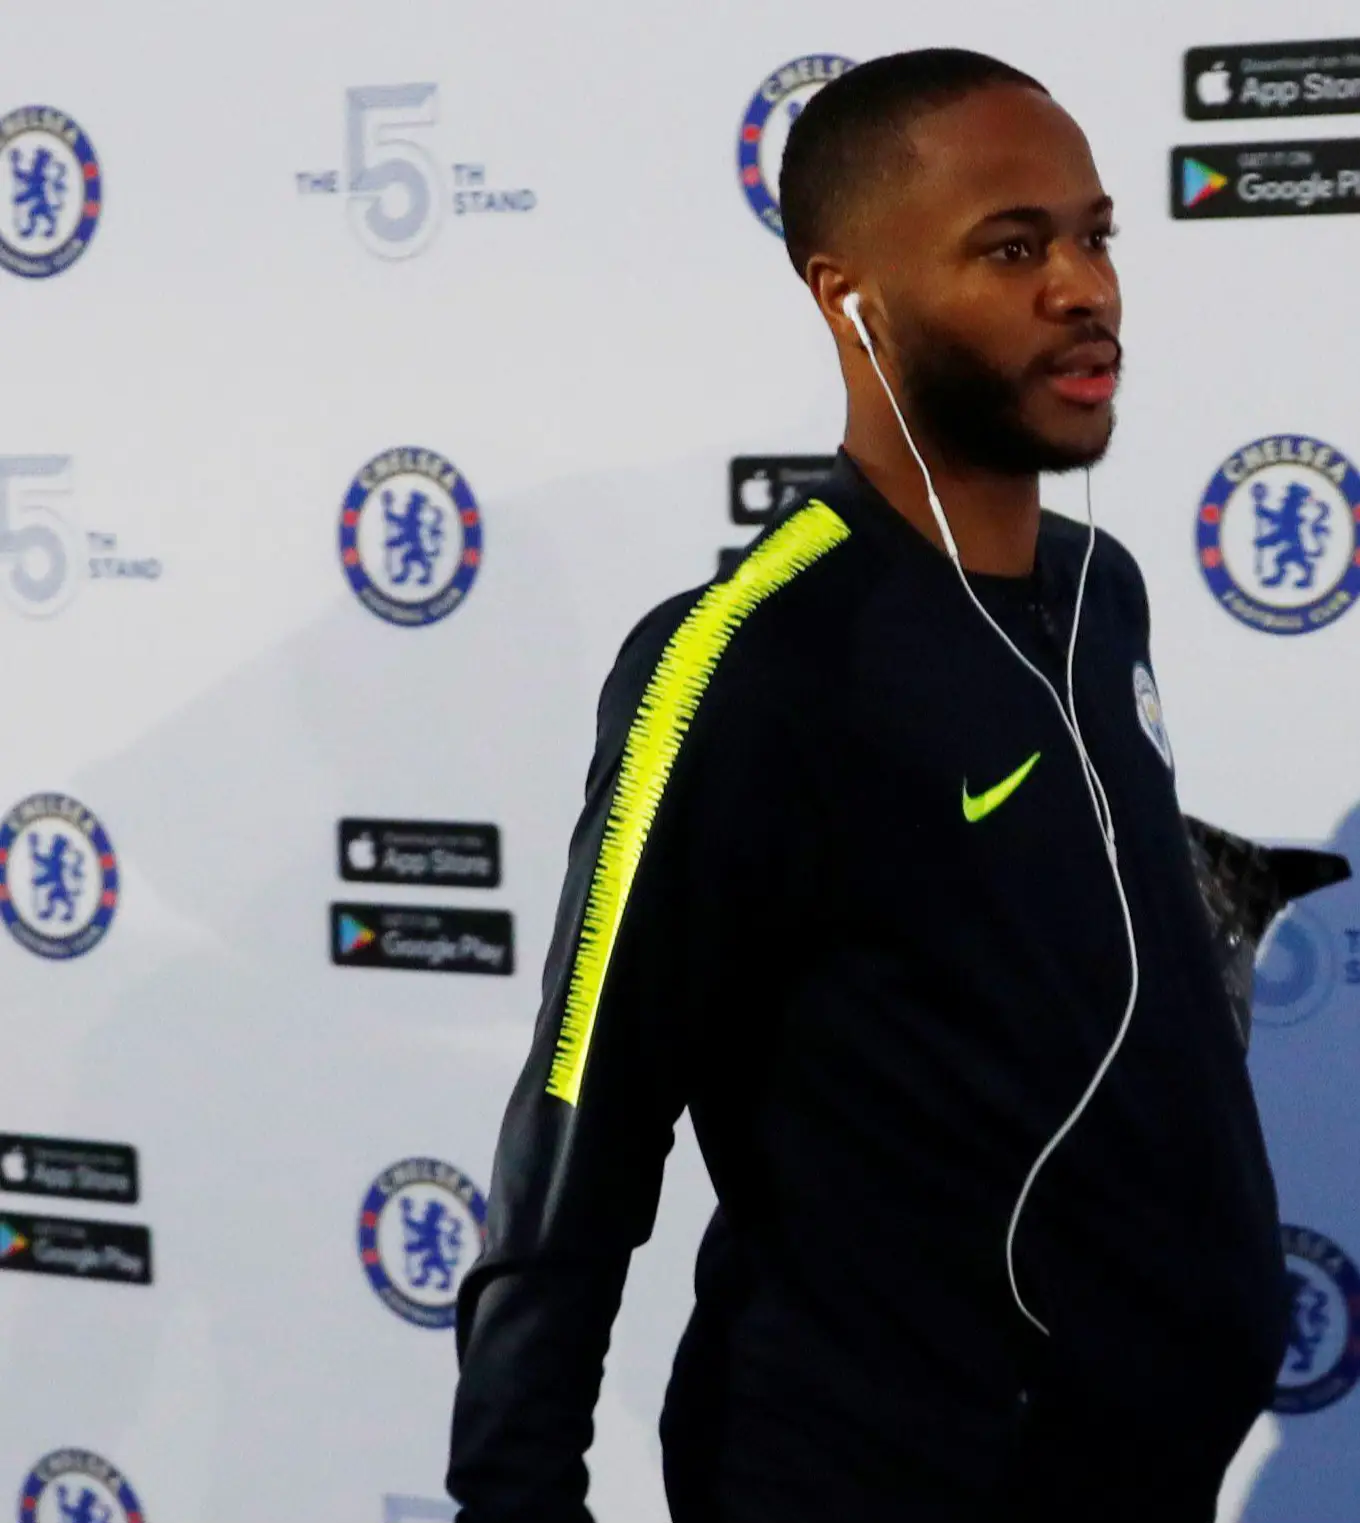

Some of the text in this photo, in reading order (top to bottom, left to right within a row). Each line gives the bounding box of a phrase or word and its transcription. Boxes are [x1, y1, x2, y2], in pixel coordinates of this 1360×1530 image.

[760, 57, 848, 102] CHELS
[1240, 76, 1300, 109] App
[295, 168, 338, 194] THE
[1237, 172, 1334, 208] Google
[452, 188, 538, 216] STAND
[358, 449, 462, 489] CHELSEA
[1222, 437, 1348, 484] CHELSEA
[381, 848, 491, 878] App Store
[381, 929, 505, 967] Google Play
